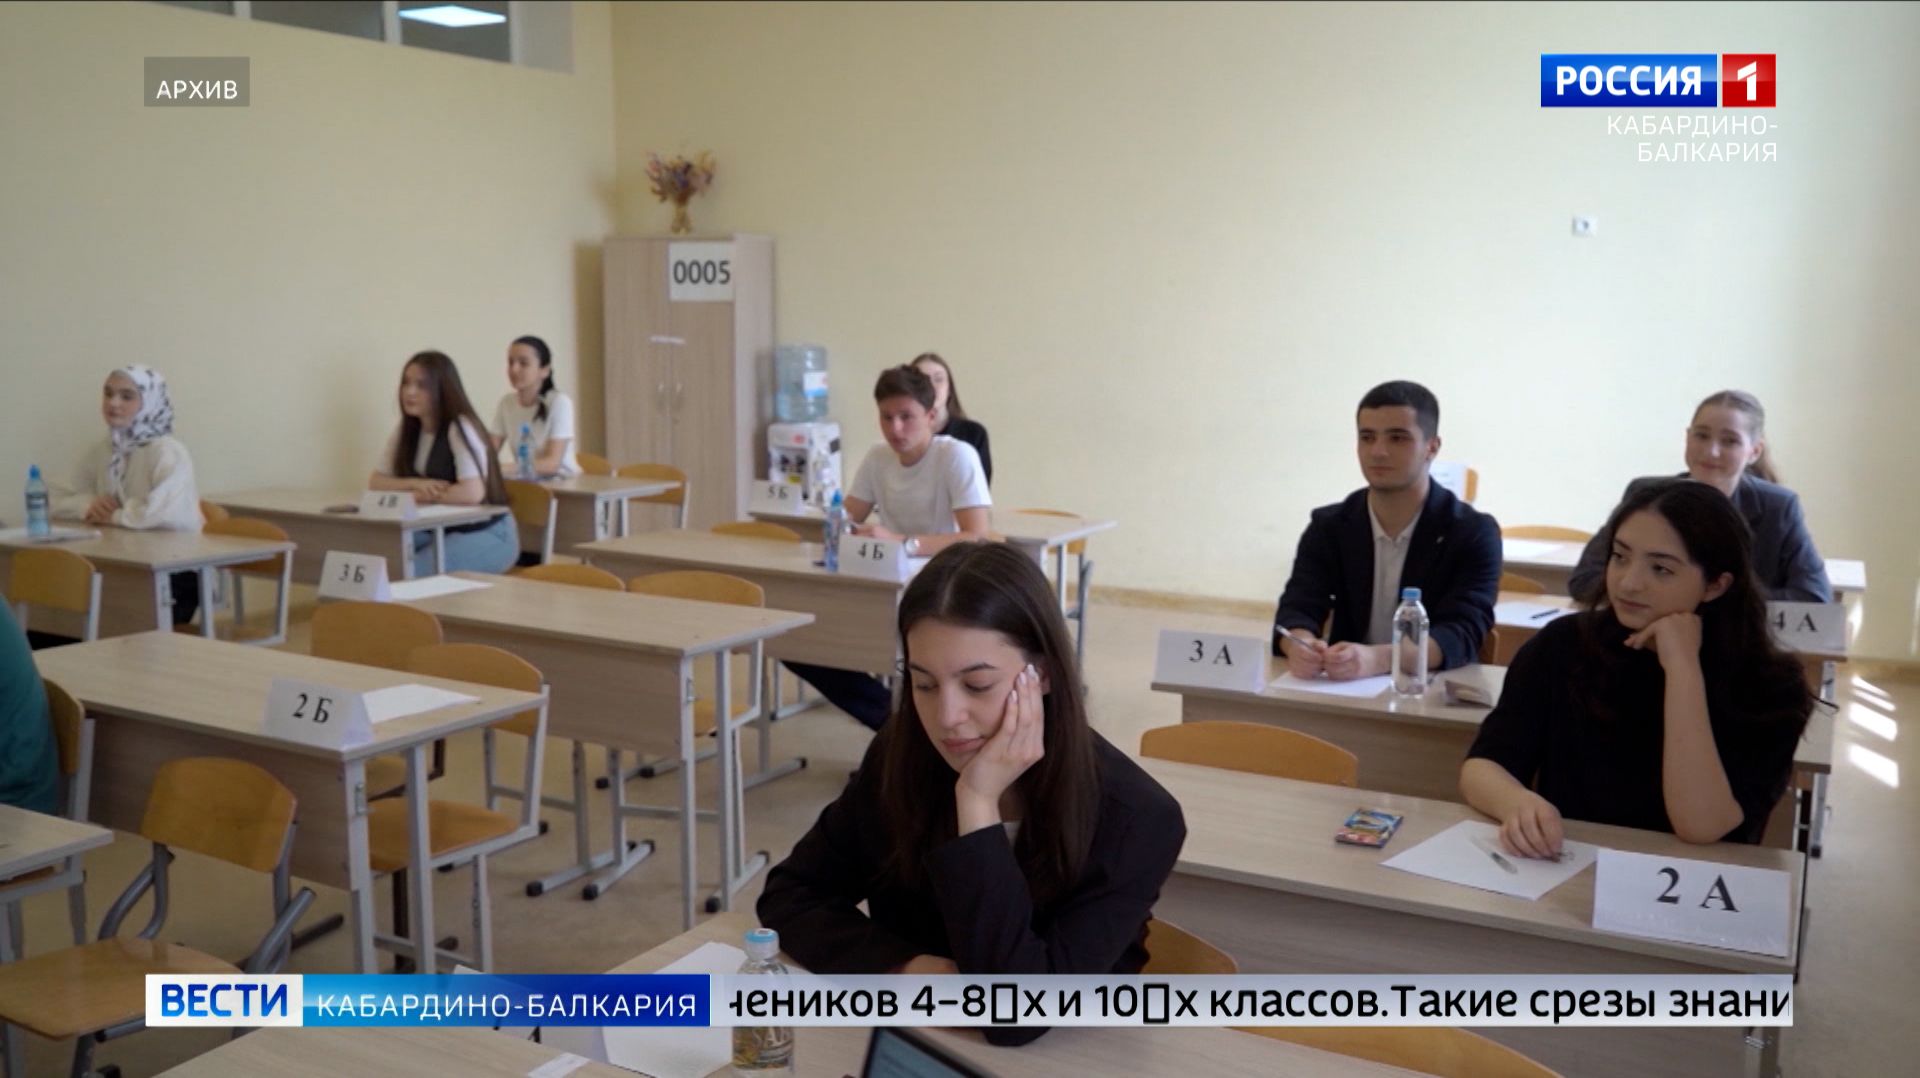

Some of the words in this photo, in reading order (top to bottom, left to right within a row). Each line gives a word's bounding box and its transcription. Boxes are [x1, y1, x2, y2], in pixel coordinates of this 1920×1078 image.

[673, 259, 731, 286] 0005
[857, 542, 867, 559] 4
[873, 543, 885, 560] Б
[338, 563, 350, 582] 3
[353, 565, 367, 584] Б
[1796, 612, 1818, 633] А
[1188, 639, 1204, 663] 3
[1212, 643, 1234, 668] А
[292, 692, 308, 720] 2
[312, 696, 333, 725] Б
[1656, 866, 1681, 905] 2
[1699, 874, 1741, 913] А
